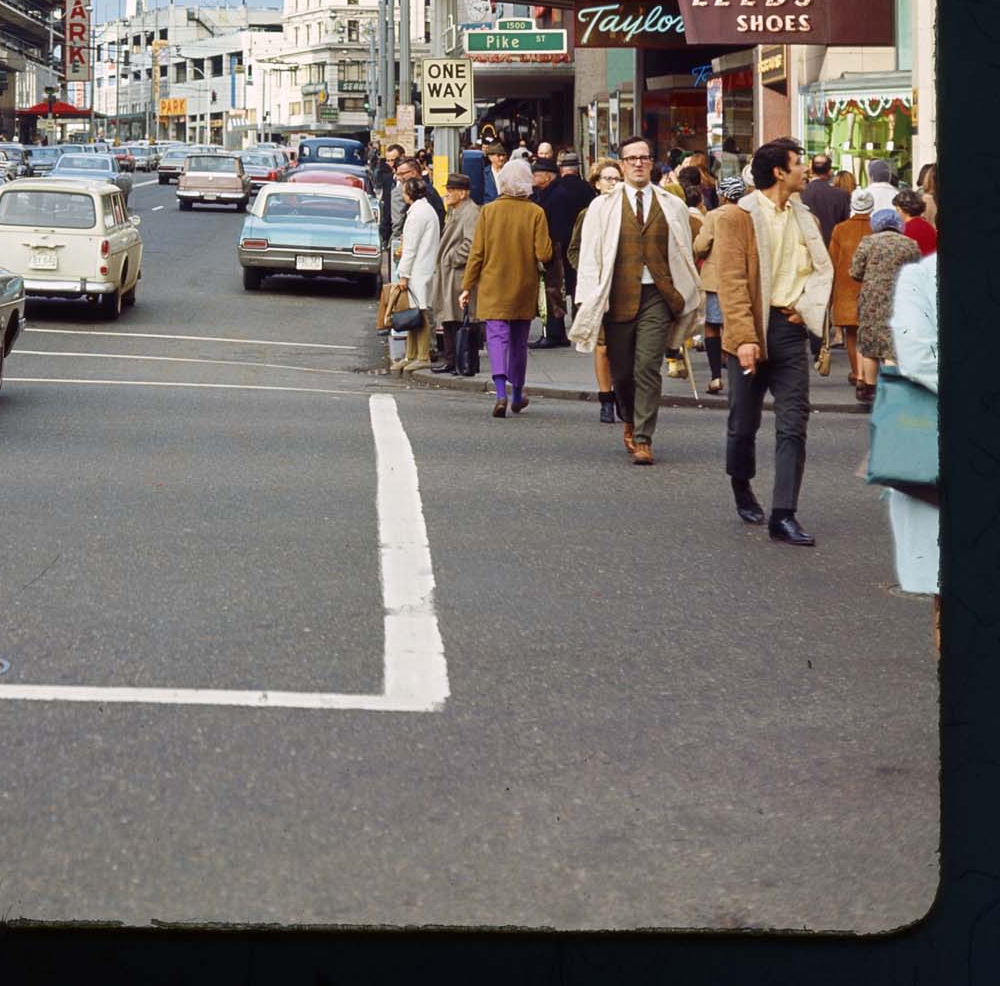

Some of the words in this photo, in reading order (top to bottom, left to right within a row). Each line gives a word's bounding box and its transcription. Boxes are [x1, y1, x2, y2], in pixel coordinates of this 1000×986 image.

[506, 21, 526, 30] 1500
[578, 4, 685, 45] Taylor
[736, 14, 811, 32] SHOES
[486, 35, 520, 48] Pike
[535, 35, 546, 43] ST
[428, 64, 466, 79] ONE
[427, 83, 467, 98] WAY
[161, 100, 186, 114] PARK
